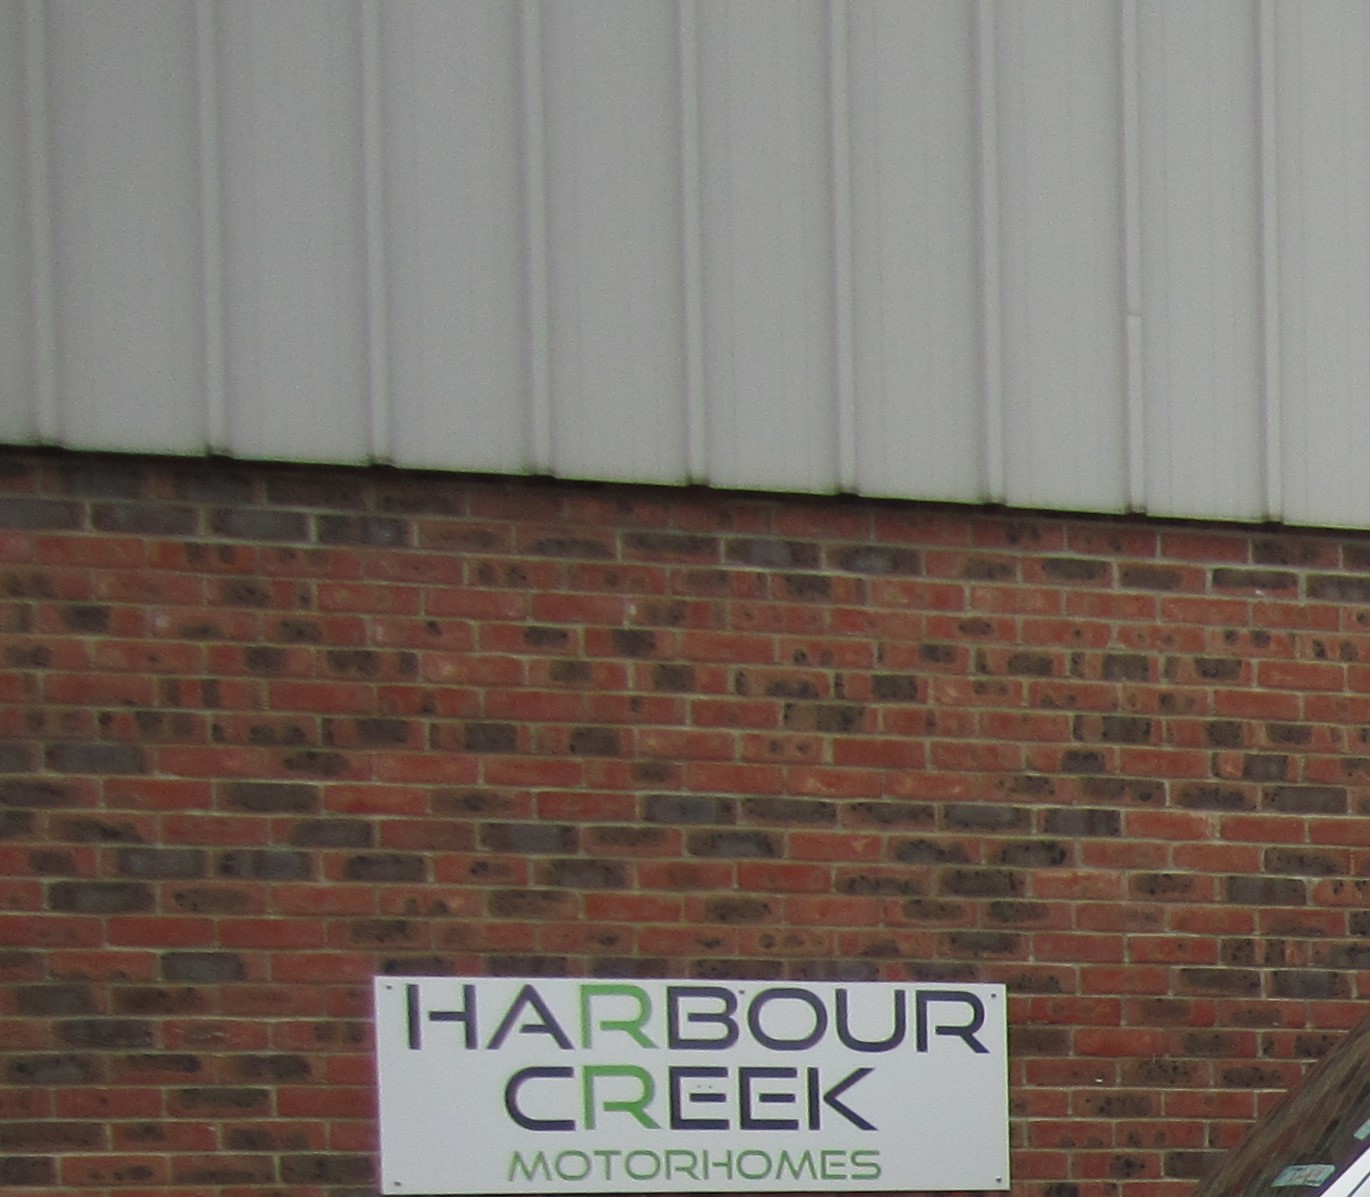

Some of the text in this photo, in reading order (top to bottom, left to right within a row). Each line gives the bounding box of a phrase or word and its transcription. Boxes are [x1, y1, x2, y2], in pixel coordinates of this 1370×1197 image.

[406, 983, 989, 1053] HARBOUR
[504, 1064, 878, 1131] CREEK
[508, 1149, 881, 1181] MOTORHOMES
